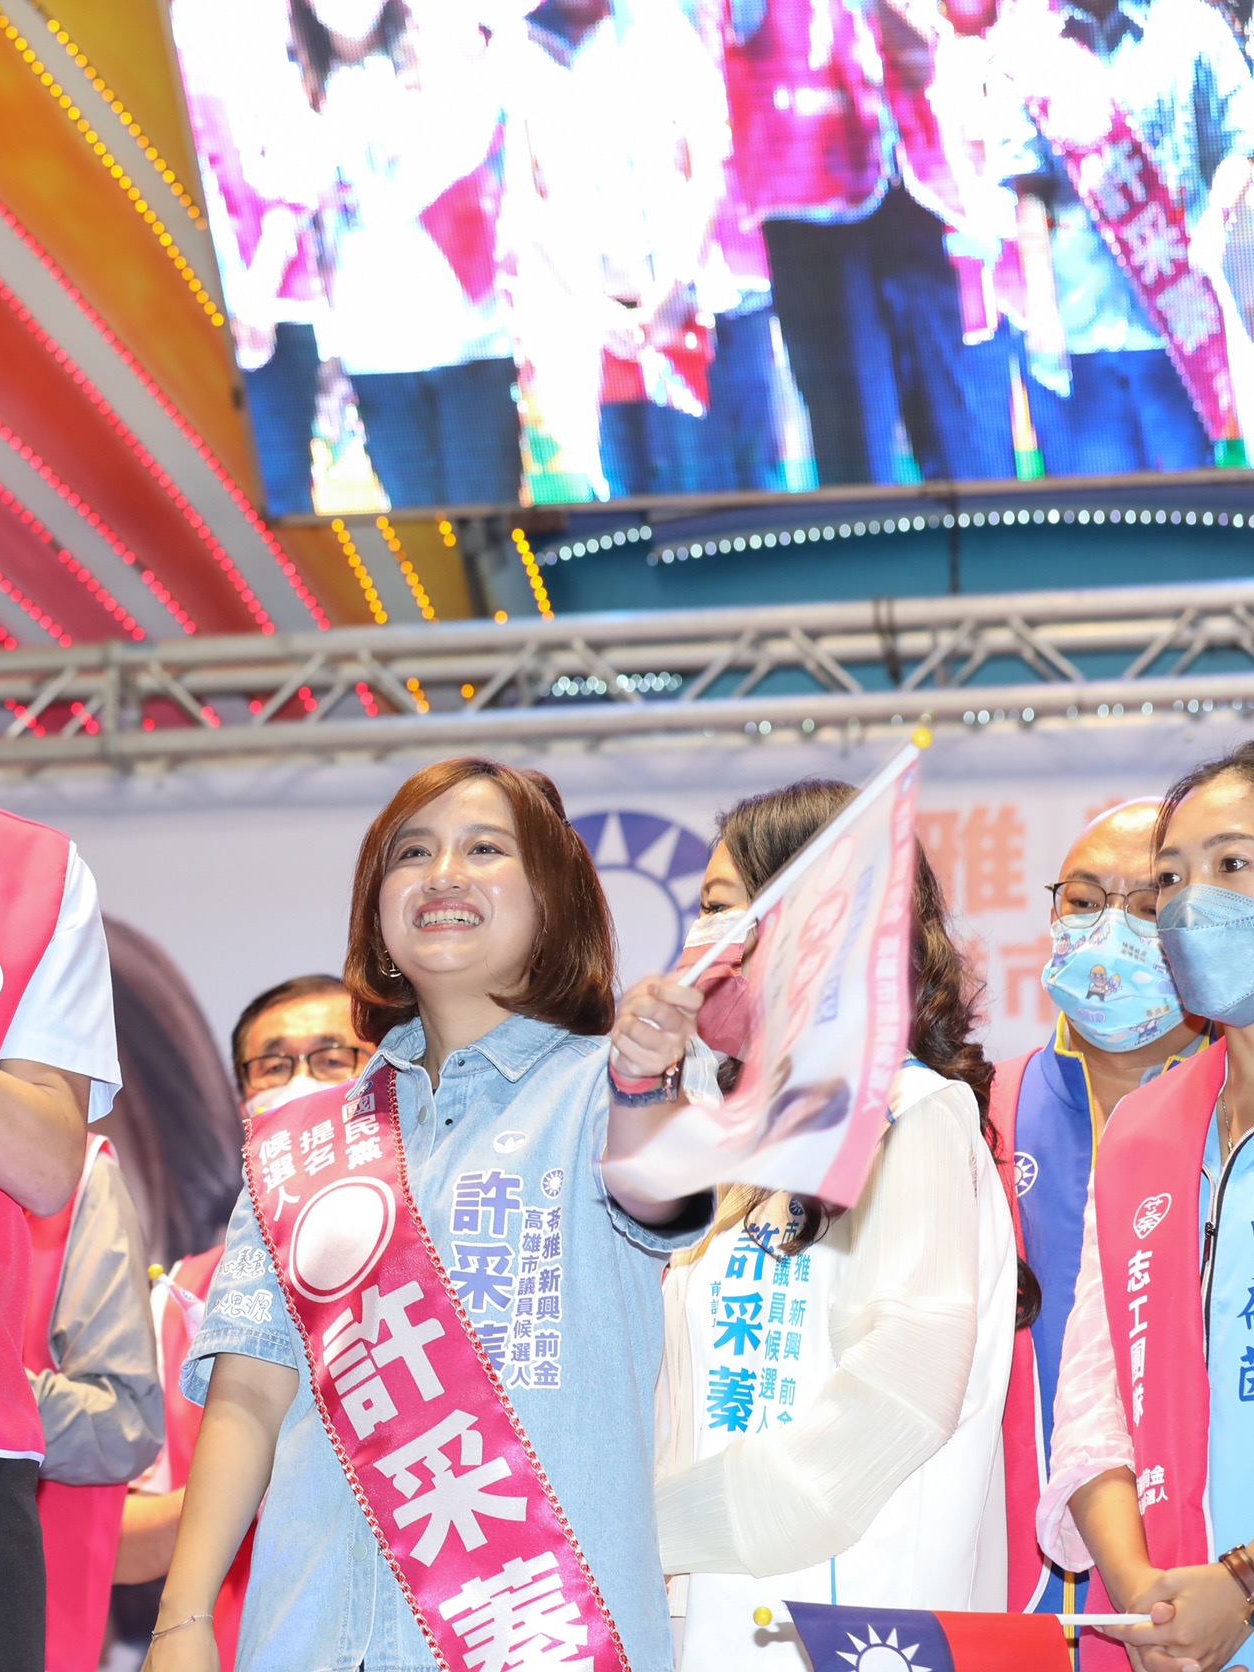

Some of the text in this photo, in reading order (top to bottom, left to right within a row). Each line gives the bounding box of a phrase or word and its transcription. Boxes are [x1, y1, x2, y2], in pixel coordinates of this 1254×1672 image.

[258, 1129, 301, 1222] 候選人
[299, 1119, 335, 1176] 提名
[510, 1209, 544, 1387] 高雄市議員候選人
[533, 1207, 561, 1387] 苓雅 新興 前金
[706, 1222, 780, 1433] 許采蓁
[783, 1298, 807, 1361] 新興
[322, 1281, 595, 1672] 許采蓁
